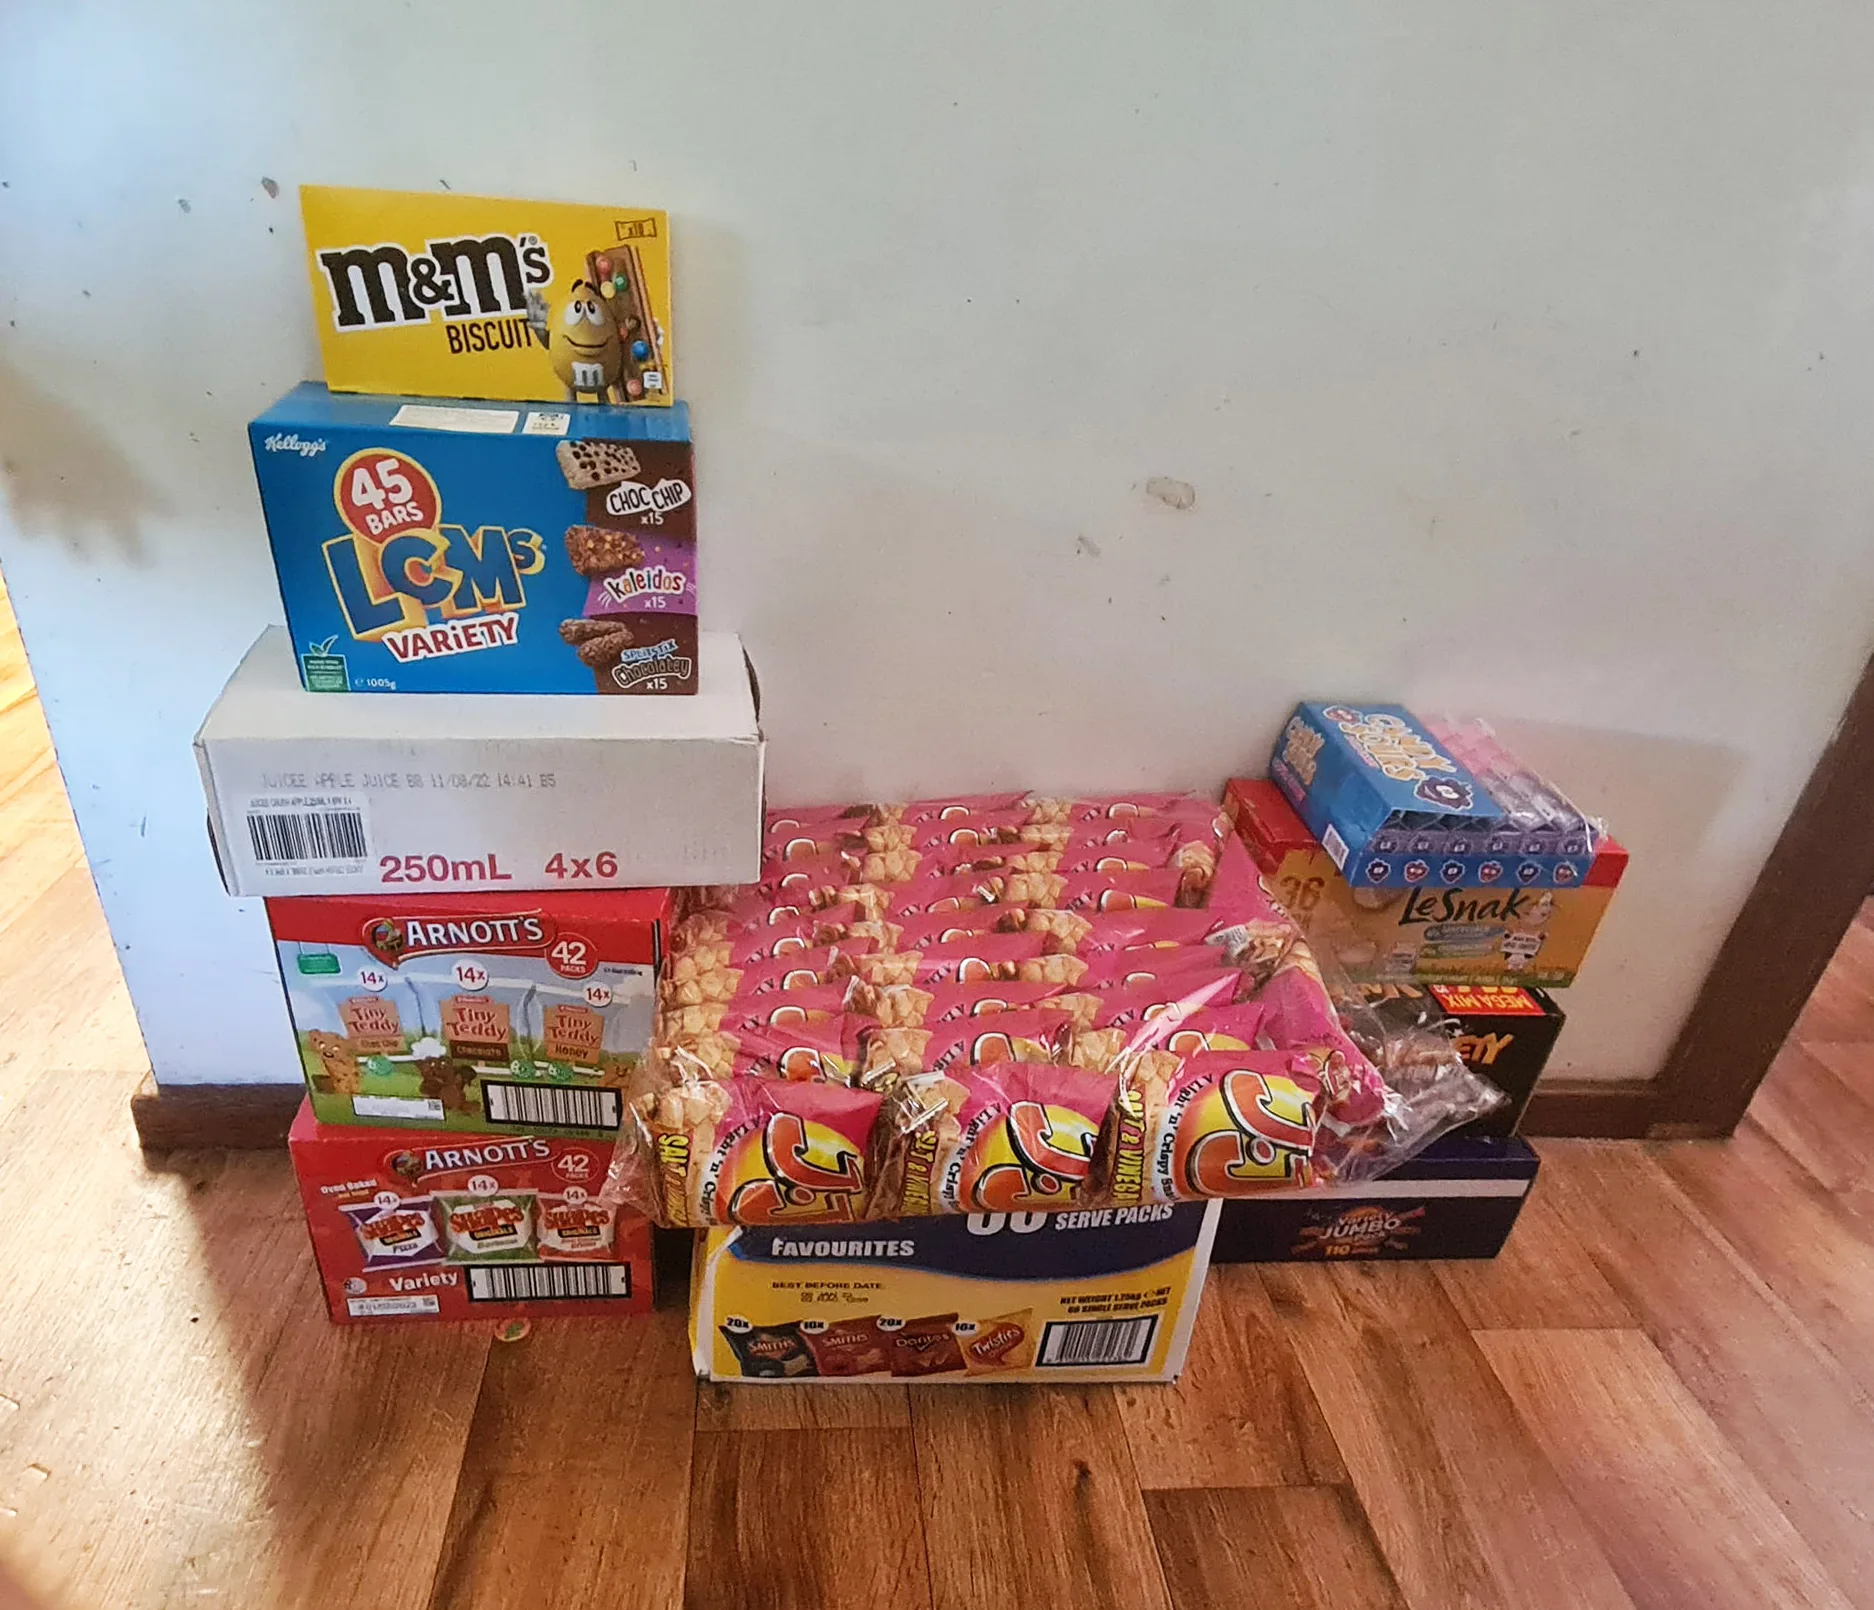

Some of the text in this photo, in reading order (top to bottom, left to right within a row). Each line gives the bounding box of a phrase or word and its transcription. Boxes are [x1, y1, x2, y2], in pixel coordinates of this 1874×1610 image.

[264, 432, 327, 457] Kellogg's
[351, 458, 413, 510] 45
[609, 483, 683, 513] CHOC CHIP
[365, 501, 424, 535] BARS
[640, 512, 664, 525] x15
[644, 596, 666, 609] x15
[646, 678, 668, 690] x15
[363, 773, 399, 788] JUICE
[380, 852, 618, 883] 250mL 4x6
[407, 917, 544, 946] ARNOTT'S
[551, 941, 587, 965] 42
[360, 971, 385, 984] 14x
[456, 966, 486, 983] 14x
[586, 988, 610, 1001] 14x
[1442, 994, 1534, 1009] MEGA MIX
[352, 1007, 387, 1021] Tiny
[452, 1007, 496, 1024] Tiny
[555, 1015, 592, 1029] Tiny
[348, 1020, 400, 1037] Teddy
[446, 1022, 507, 1041] Teddy
[548, 1026, 599, 1046] Teddy
[555, 1044, 589, 1060] Honey
[425, 1139, 550, 1170] ARNOTT'S
[557, 1154, 589, 1172] 42
[1157, 1133, 1175, 1175] Crispy
[471, 1179, 495, 1191] 14x
[1055, 1209, 1112, 1231] SERVE
[1115, 1202, 1174, 1224] PACKS
[1320, 1218, 1401, 1240] JUMBO
[772, 1237, 915, 1257] FAVOURITES
[389, 1272, 457, 1291] Variety
[896, 1333, 949, 1348] Doritos
[971, 1328, 1021, 1357] Twisties
